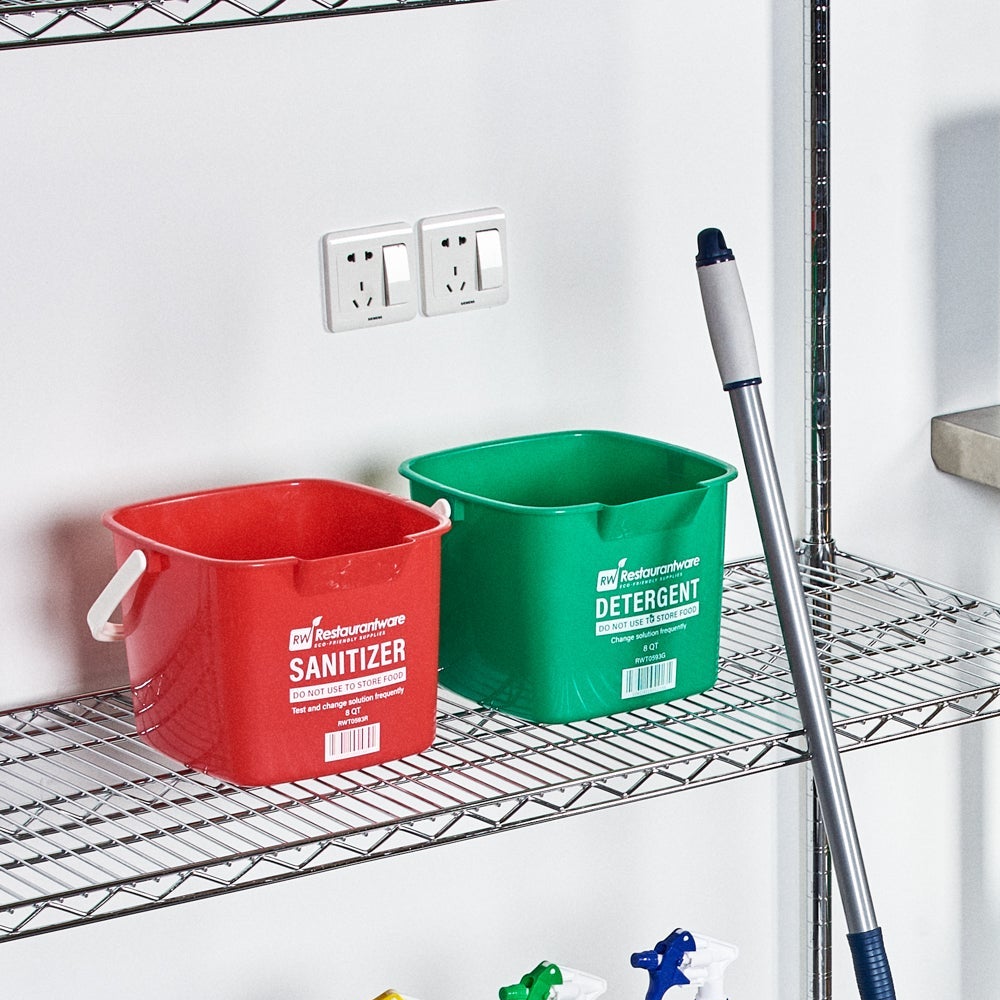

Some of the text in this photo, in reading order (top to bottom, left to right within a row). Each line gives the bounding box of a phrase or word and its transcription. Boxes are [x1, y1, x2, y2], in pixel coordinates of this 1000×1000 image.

[600, 556, 701, 586] RW Restaurantware
[595, 577, 700, 619] DETERGENT
[292, 614, 406, 645] RW Restaurantware
[598, 624, 611, 633] DO
[612, 621, 628, 631] NOT
[629, 618, 644, 628] USE
[656, 611, 678, 623] STORE
[679, 605, 698, 617] FOOD
[610, 622, 687, 644] Change solution frequently
[313, 630, 387, 649] ECO-FRIENDLY SUPPLIES
[648, 642, 659, 651] QT
[289, 638, 406, 682] SANITIZER
[292, 671, 404, 699] DO NOT USE TO STORE FOOD
[291, 686, 405, 715] Test and change solution frequently
[351, 706, 361, 716] QT
